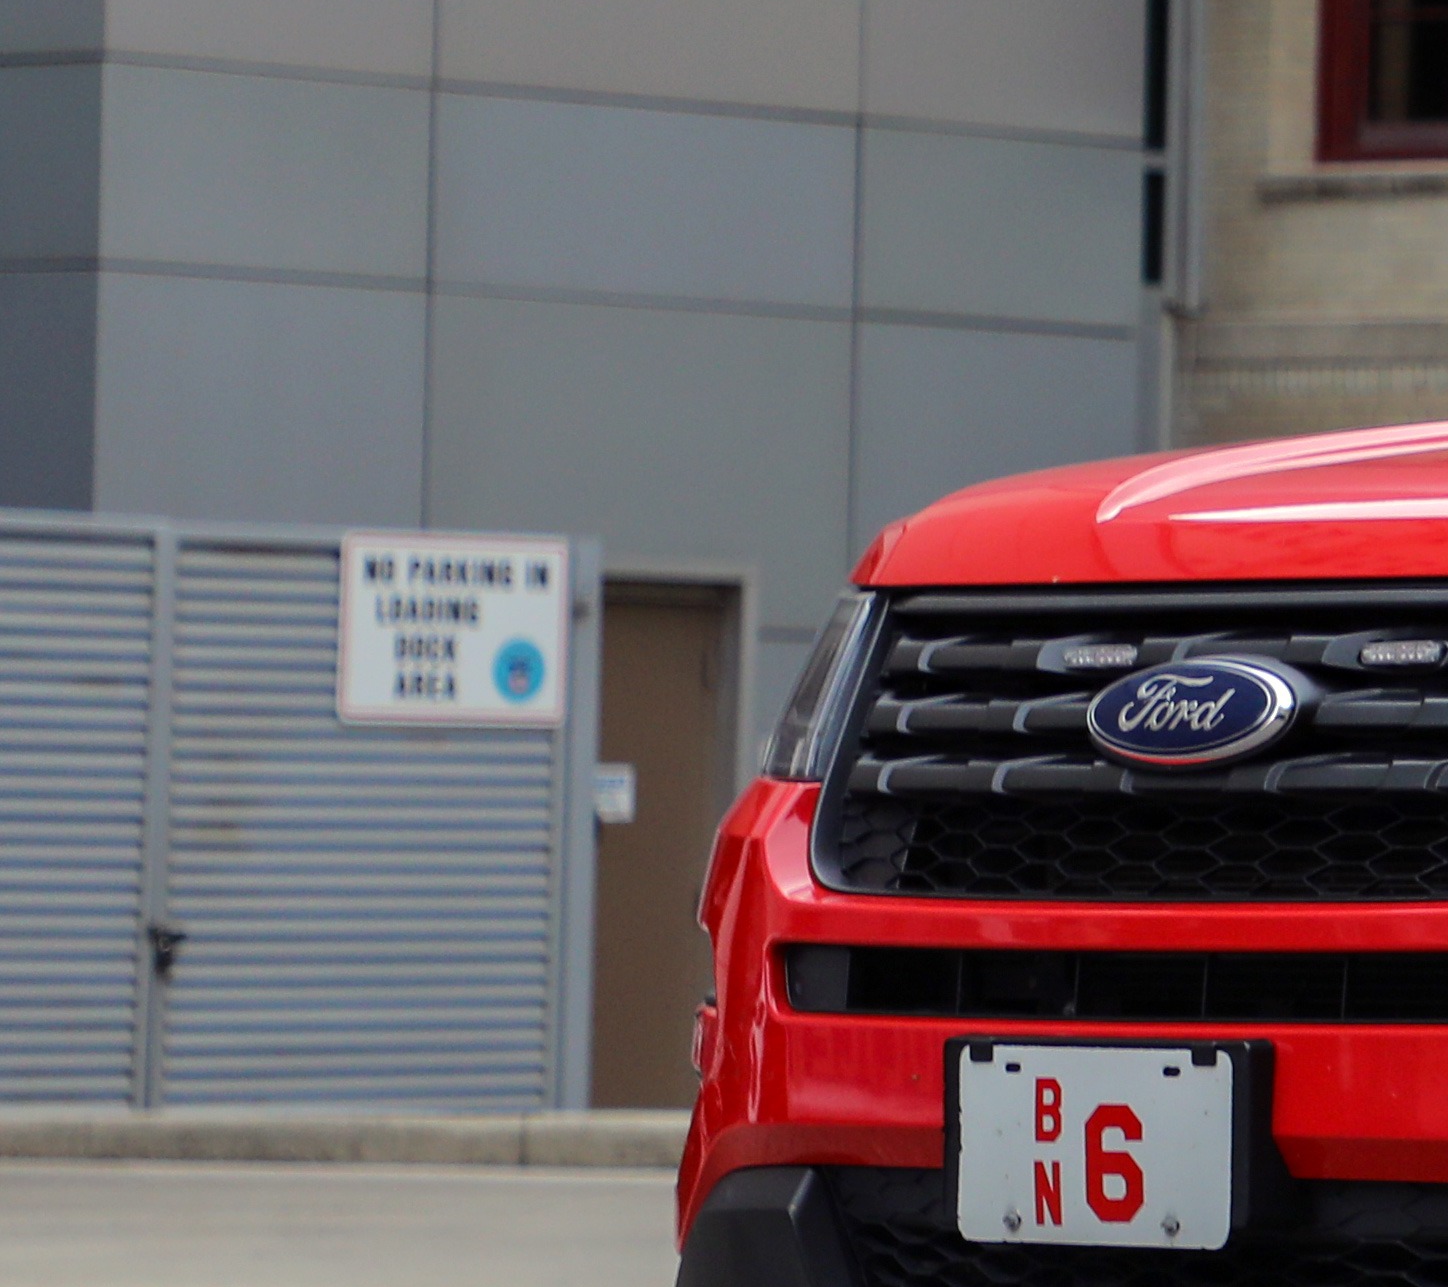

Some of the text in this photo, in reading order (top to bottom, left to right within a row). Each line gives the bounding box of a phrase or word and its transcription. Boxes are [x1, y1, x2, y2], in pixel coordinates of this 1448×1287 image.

[363, 557, 549, 589] NO PARKING IN
[375, 595, 480, 626] LOADING
[395, 634, 456, 662] DOCK
[394, 672, 456, 700] AREA
[1118, 673, 1236, 732] Ford
[1083, 1103, 1145, 1224] 6
